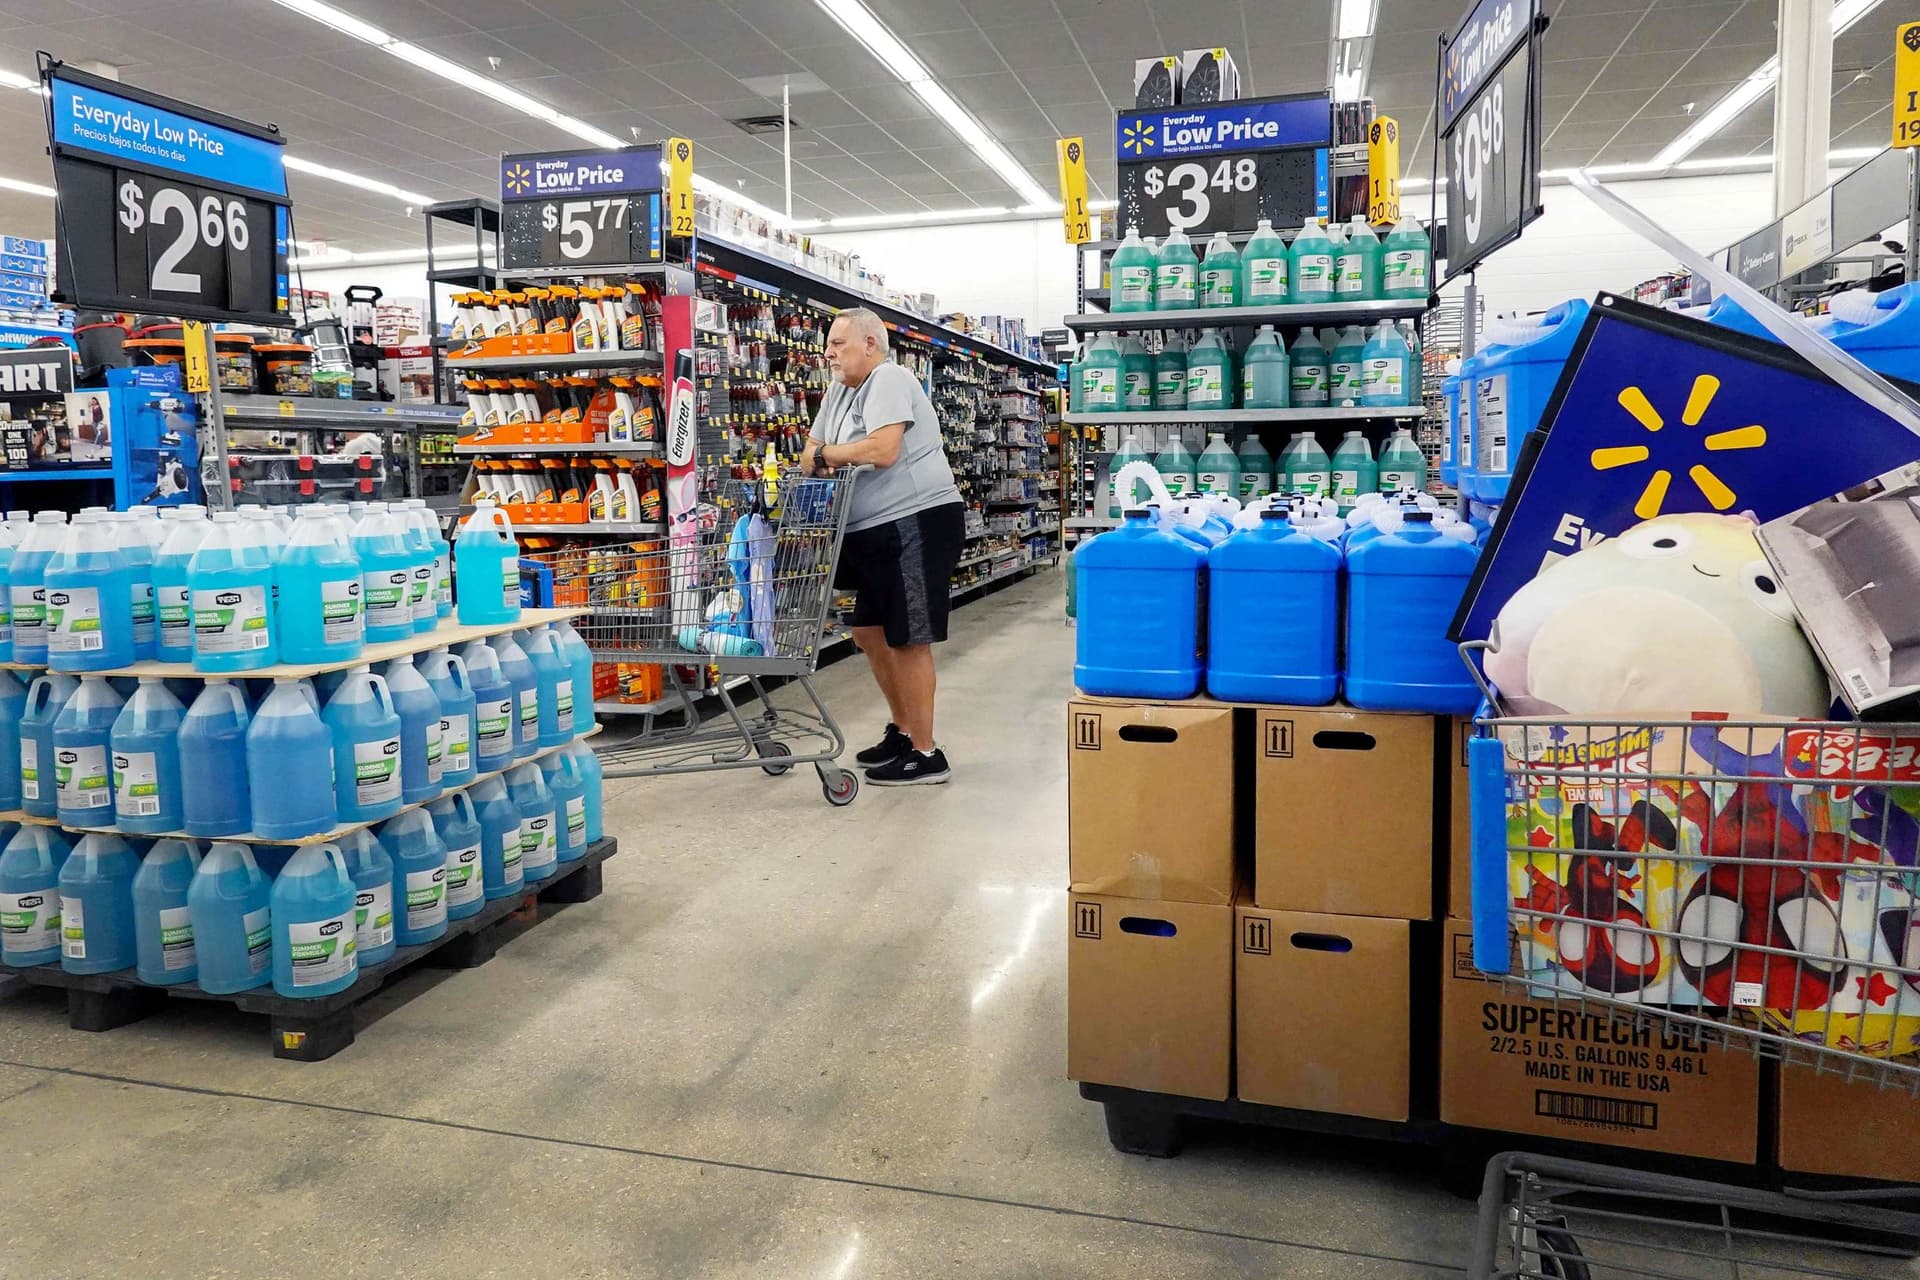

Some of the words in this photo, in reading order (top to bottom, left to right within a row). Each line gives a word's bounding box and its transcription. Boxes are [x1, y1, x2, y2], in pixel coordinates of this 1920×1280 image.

[1461, 20, 1479, 53] Everyday
[1460, 38, 1483, 94] Low
[1483, 1, 1512, 66] Price
[1906, 90, 1918, 112] I
[72, 95, 149, 140] Everyday
[154, 118, 184, 145] Low
[188, 128, 224, 156] Price
[1163, 114, 1205, 126] Everyday
[73, 122, 107, 142] Precios
[109, 133, 131, 149] bajos
[133, 139, 156, 155] todos
[158, 145, 169, 158] los
[1163, 127, 1212, 146] Low
[1217, 118, 1279, 141] Price
[536, 160, 569, 171] Everyday
[536, 170, 575, 188] Low
[577, 165, 624, 185] Price
[1374, 179, 1380, 198] I
[680, 193, 687, 210] I
[1076, 197, 1083, 215] I
[1387, 201, 1399, 220] 20
[1371, 202, 1385, 223] 20
[676, 216, 693, 232] 22
[1077, 223, 1089, 240] 21
[191, 356, 198, 370] I
[189, 375, 202, 389] 24
[8, 431, 22, 439] ONE
[672, 400, 690, 459] Energizer
[7, 448, 28, 460] 100
[1578, 727, 1650, 764] AMAZING
[1516, 750, 1649, 787] SPIDEY
[291, 944, 322, 952] SUMMER
[291, 949, 327, 958] FORMULA
[1482, 1002, 1650, 1048] SUPERTECH
[1490, 1036, 1532, 1056] 2/2.5
[1538, 1042, 1569, 1061] U.S.
[1575, 1045, 1649, 1069] GALLONS
[1656, 1054, 1693, 1073] 9.46
[1698, 1057, 1708, 1075] L
[1525, 1060, 1570, 1082] MADE
[1577, 1065, 1595, 1084] IN
[1600, 1069, 1630, 1088] THE
[1637, 1074, 1671, 1093] USA
